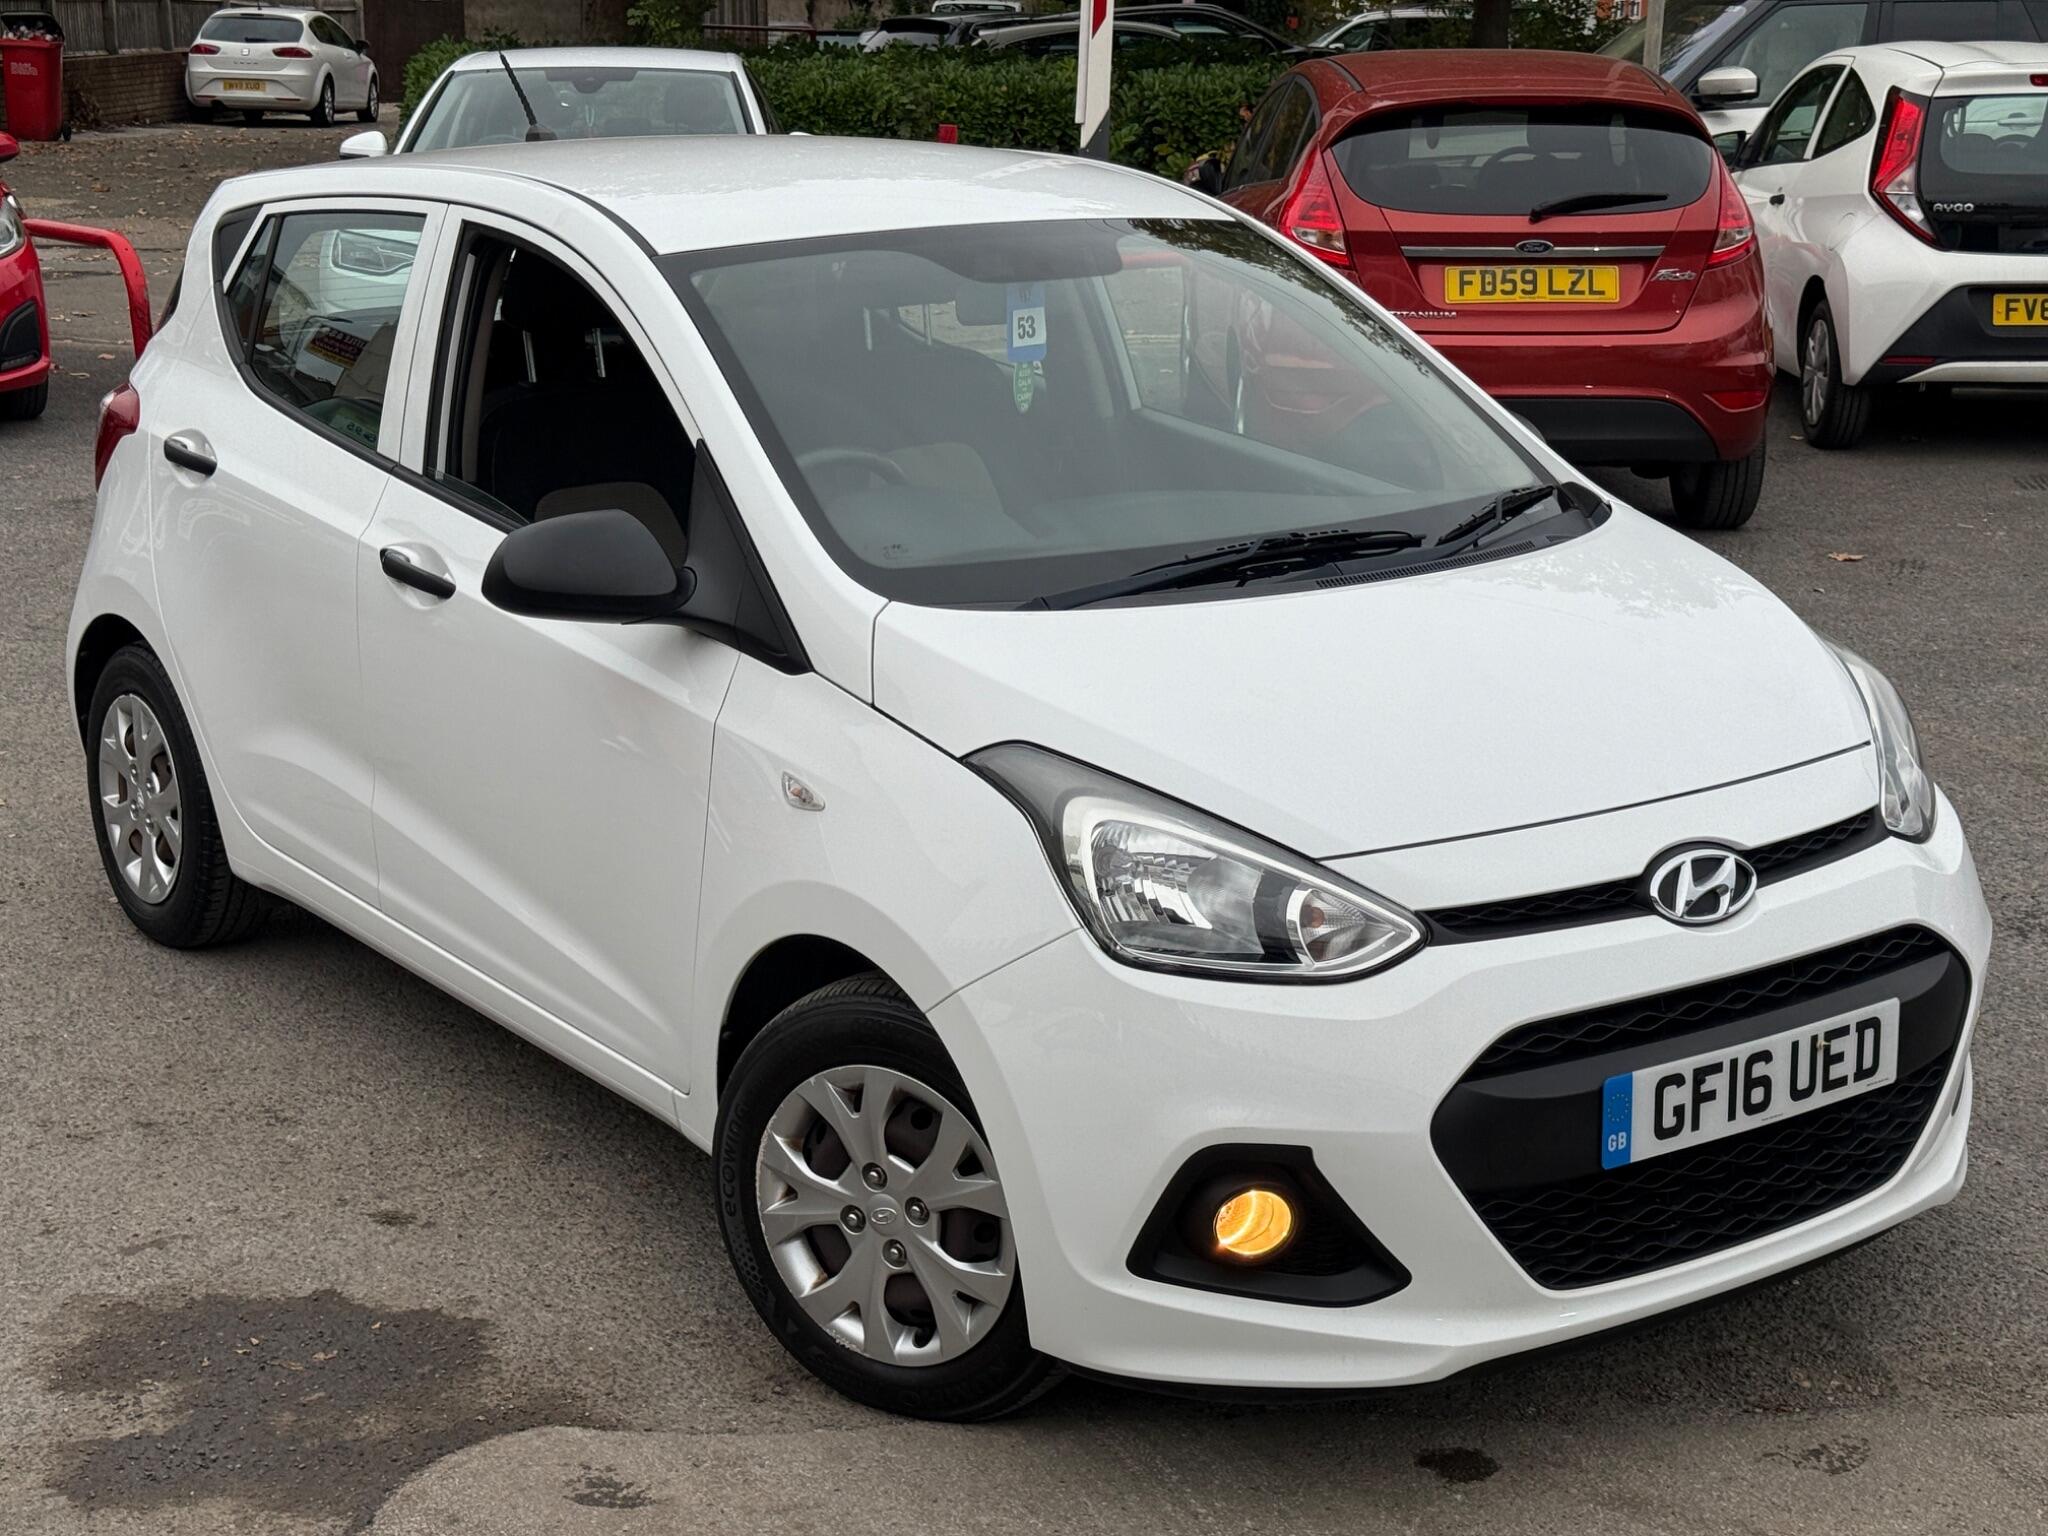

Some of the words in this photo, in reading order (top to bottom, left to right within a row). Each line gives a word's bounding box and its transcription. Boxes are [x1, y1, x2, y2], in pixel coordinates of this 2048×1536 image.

[1933, 203, 1974, 212] AYGO
[1458, 268, 1538, 297] FD59
[1547, 268, 1606, 296] LZL
[1017, 315, 1036, 340] 53
[1653, 1049, 1774, 1141] GF16
[1789, 1016, 1882, 1103] UED
[1607, 1131, 1627, 1153] GB
